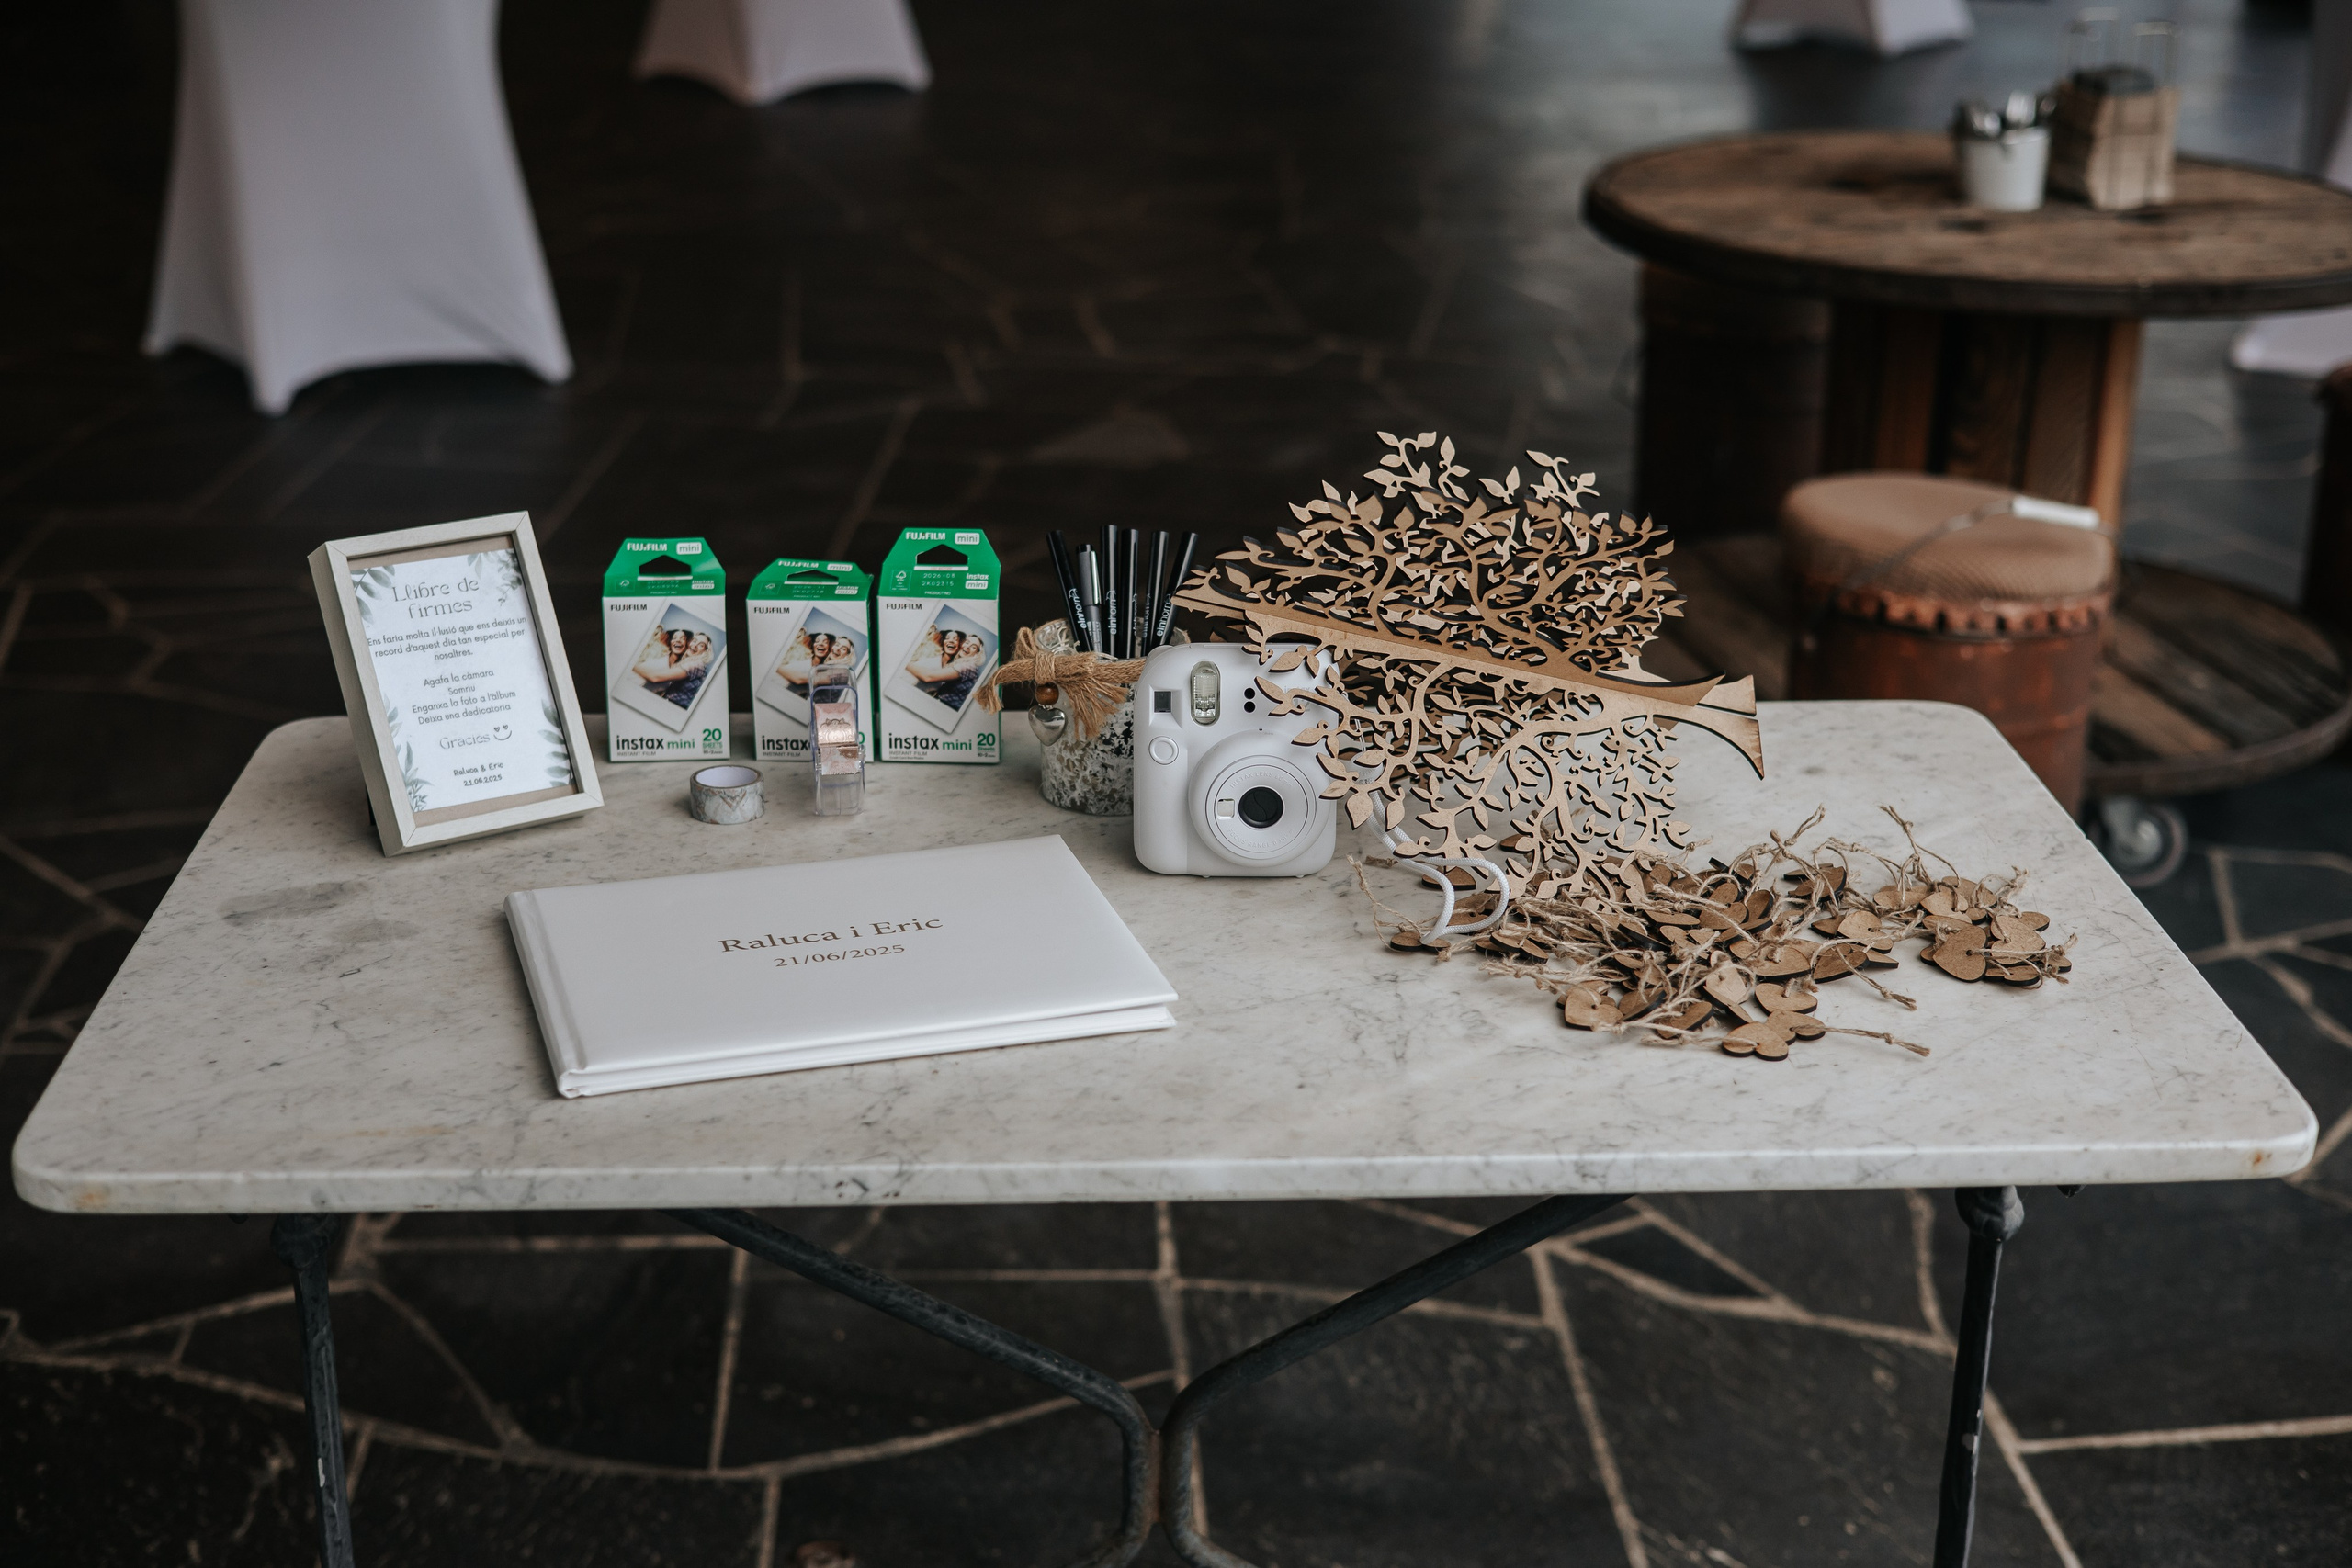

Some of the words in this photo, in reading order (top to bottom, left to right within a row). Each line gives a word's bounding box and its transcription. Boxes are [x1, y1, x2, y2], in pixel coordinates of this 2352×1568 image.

[905, 531, 945, 540] FUJIFILM
[957, 535, 978, 543] mini
[627, 542, 668, 551] FUJIFILM
[679, 544, 700, 552] mini
[391, 581, 450, 602] Llibre
[458, 577, 480, 592] de
[408, 599, 473, 619] firmes
[610, 604, 648, 612] FUJIFILM
[1072, 597, 1087, 629] einhorn
[1107, 599, 1117, 635] einhorn
[1157, 603, 1172, 637] einhorn
[368, 637, 381, 647] Ens
[383, 634, 404, 644] faria
[406, 630, 430, 641] molta
[458, 624, 474, 635] que
[476, 621, 491, 630] ens
[492, 616, 515, 627] deixis
[517, 616, 526, 625] un
[375, 645, 403, 658] record
[442, 637, 457, 648] dia
[458, 636, 472, 646] tan
[474, 630, 509, 643] especial
[511, 628, 526, 640] per
[434, 649, 474, 660] nosaltres.
[424, 675, 449, 688] Agafa
[451, 673, 460, 682] la
[462, 670, 494, 681] càmara
[447, 684, 476, 695] Somriu
[412, 702, 448, 714] Enganxa
[449, 698, 458, 707] la
[460, 696, 478, 706] foto
[418, 714, 443, 725] Deixa
[445, 711, 460, 721] una
[462, 704, 512, 717] dedicatoria
[616, 735, 664, 750] instax
[667, 738, 695, 750] mini
[702, 728, 723, 742] 20
[762, 735, 809, 751] instax
[888, 733, 939, 750] instax
[942, 739, 972, 750] mini
[977, 732, 996, 747] 20
[453, 767, 479, 777] Raluca
[481, 764, 487, 773] &
[488, 762, 504, 771] Eric
[463, 773, 503, 787] 21.06.2025
[718, 931, 842, 953] Raluca
[849, 926, 863, 939] i
[869, 918, 944, 935] Eric
[774, 944, 906, 967] 21/06/2025
